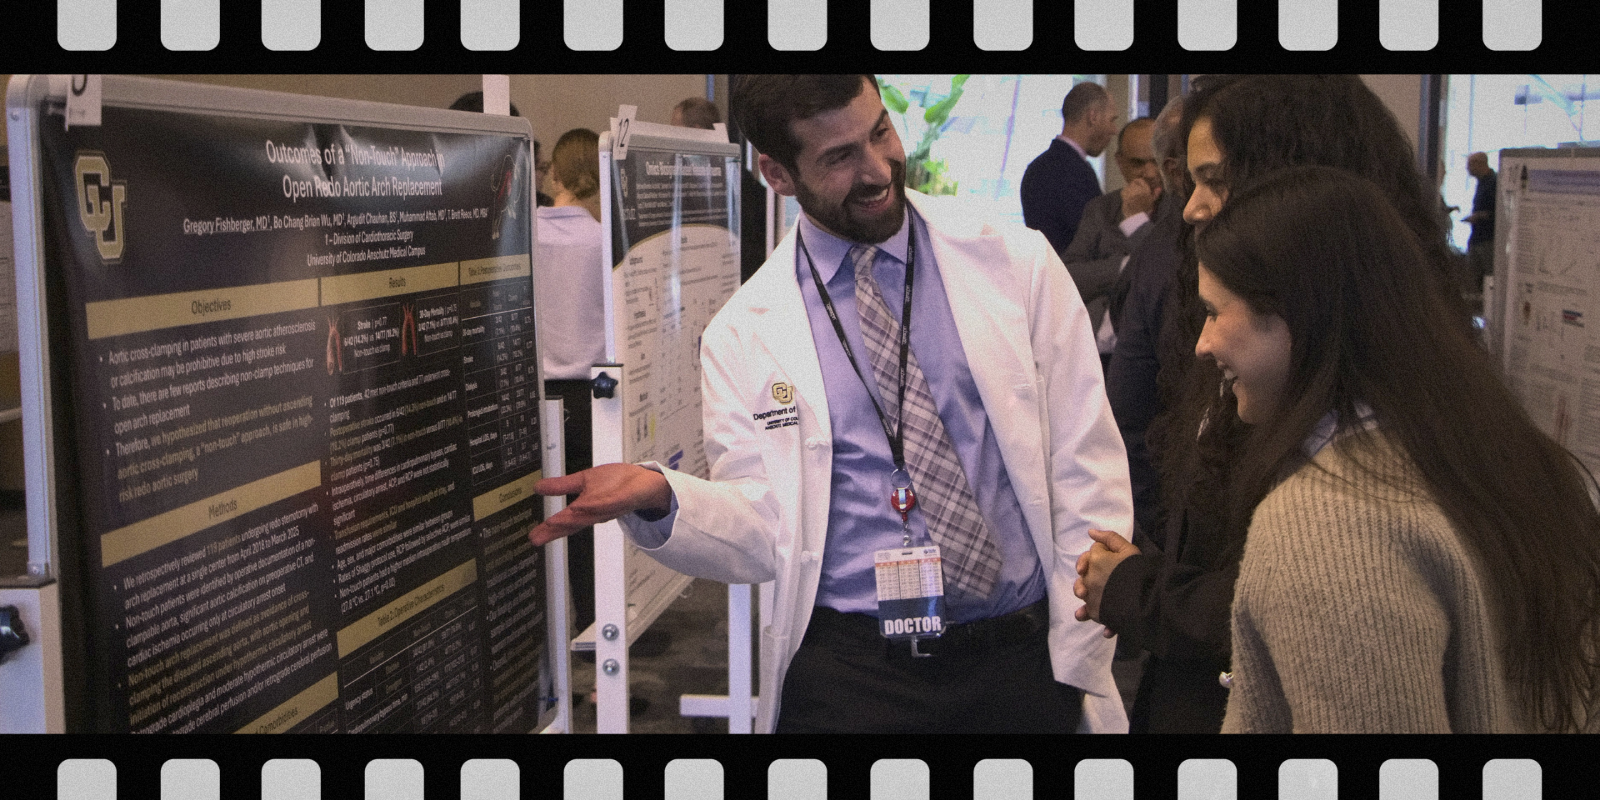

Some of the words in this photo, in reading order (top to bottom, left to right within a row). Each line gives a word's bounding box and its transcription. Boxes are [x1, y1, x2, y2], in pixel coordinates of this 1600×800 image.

[265, 140, 321, 163] Outcomes
[323, 144, 335, 164] of
[338, 150, 344, 164] a
[400, 148, 436, 171] Approach
[282, 176, 312, 202] Open
[313, 176, 340, 197] Redo
[342, 177, 369, 196] Aortic
[371, 177, 390, 196] Arch
[392, 178, 442, 200] Replacement
[183, 219, 214, 236] Gregory
[215, 217, 255, 233] Fishberger,
[273, 215, 282, 228] Bo
[283, 215, 303, 230] Chang
[304, 214, 320, 227] Brian
[320, 214, 332, 228] Wu,
[333, 232, 355, 244] Division
[355, 232, 360, 243] of
[361, 230, 396, 242] Cardiothoracic
[396, 230, 413, 242] Surgery
[307, 253, 334, 266] University
[335, 252, 342, 263] of
[342, 250, 366, 262] Colorado
[366, 248, 389, 260] Anschutz
[389, 246, 407, 258] Medical
[407, 245, 425, 258] Campus
[191, 300, 231, 316] Objectives
[109, 350, 129, 365] Aortic
[130, 342, 181, 361] cross-clamping
[182, 340, 188, 352] in
[190, 337, 217, 354] patients
[218, 333, 232, 346] with
[233, 332, 253, 344] severe
[254, 327, 272, 340] aortic
[110, 378, 118, 388] or
[160, 367, 174, 379] may
[176, 363, 184, 375] be
[221, 355, 233, 366] due
[234, 353, 241, 364] to
[242, 349, 255, 363] high
[256, 346, 274, 359] stroke
[275, 343, 286, 355] risk
[112, 398, 120, 410] To
[140, 392, 157, 404] there
[158, 390, 169, 400] are
[170, 386, 181, 398] few
[182, 381, 205, 396] reports
[206, 373, 239, 390] describing
[305, 357, 313, 368] for
[114, 420, 131, 434] open
[132, 414, 147, 428] arch
[148, 405, 190, 425] replacement
[753, 408, 788, 420] Department
[788, 406, 796, 414] of
[208, 500, 238, 519] Methods
[884, 616, 942, 634] DOCTOR
